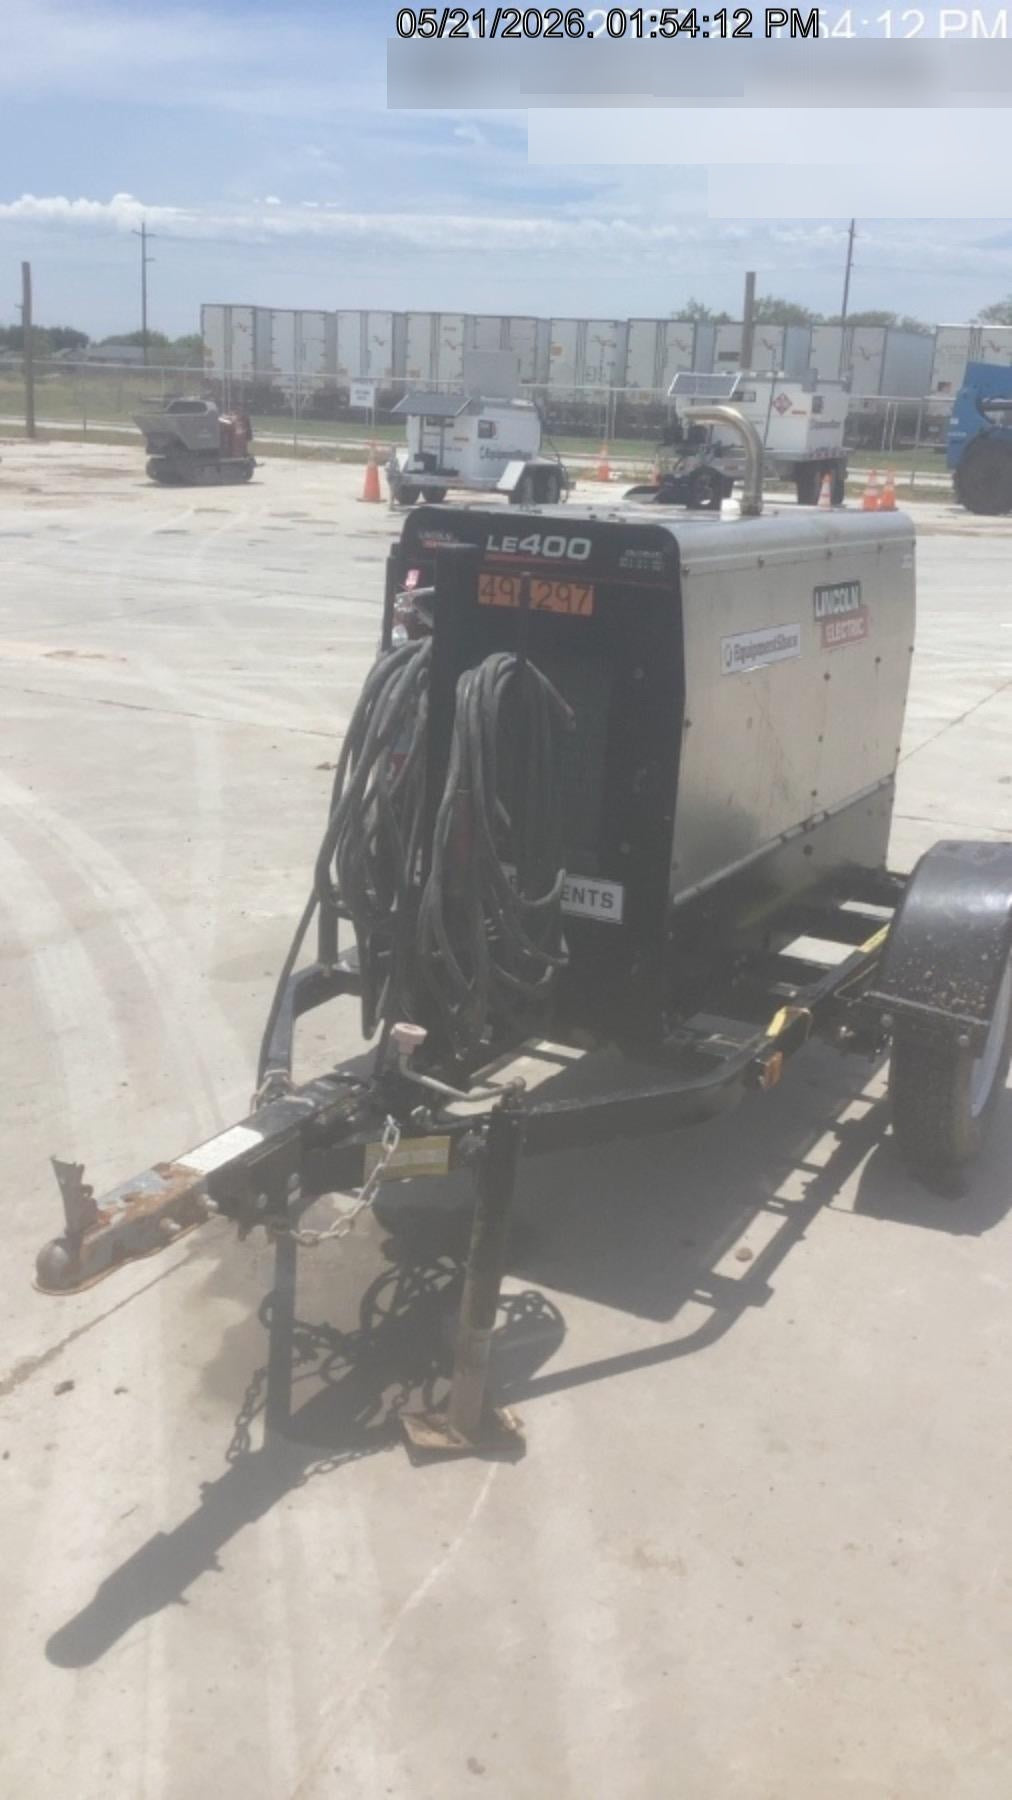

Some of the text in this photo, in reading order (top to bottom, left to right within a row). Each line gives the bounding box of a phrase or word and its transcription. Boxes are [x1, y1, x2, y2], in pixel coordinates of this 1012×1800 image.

[485, 533, 592, 561] LE400
[815, 584, 859, 617] LINCOLN
[826, 617, 864, 642] ELECTRIC
